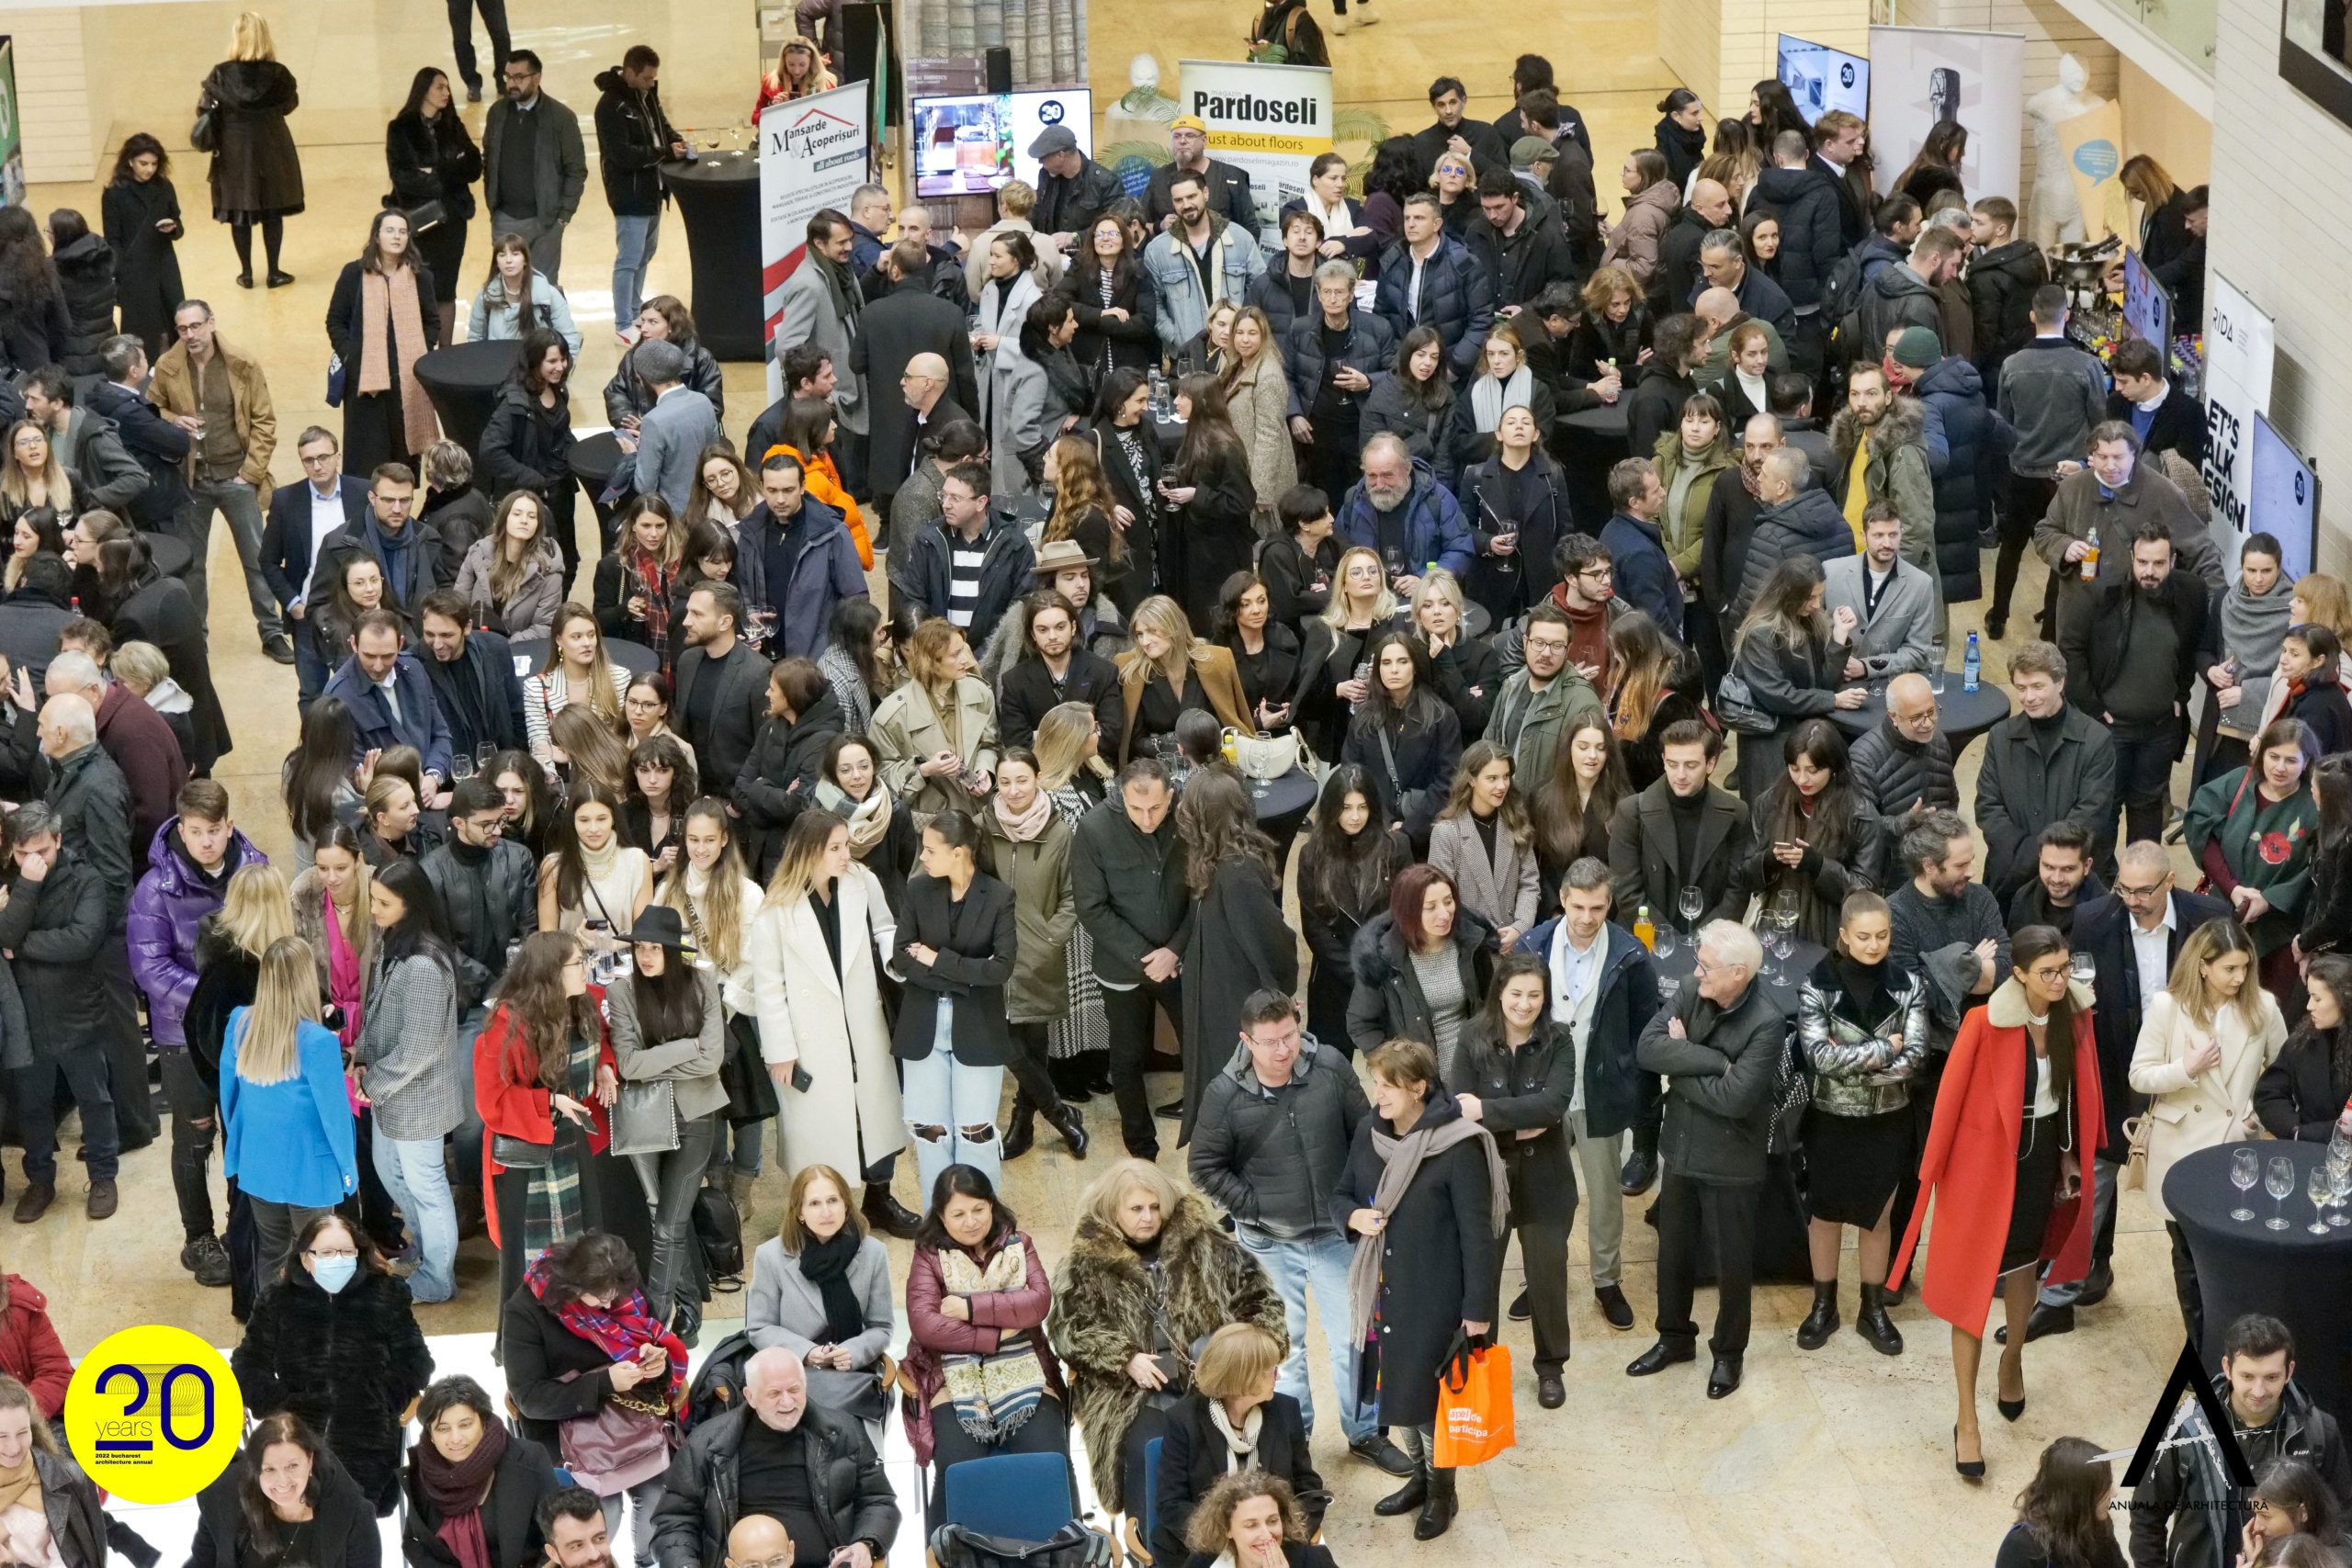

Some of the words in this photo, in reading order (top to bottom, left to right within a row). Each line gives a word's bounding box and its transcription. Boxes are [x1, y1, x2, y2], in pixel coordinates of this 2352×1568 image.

[1841, 66, 1854, 84] 20
[1210, 89, 1242, 97] magazin
[1041, 104, 1062, 121] 20
[1193, 90, 1317, 126] Pardoseli
[771, 118, 827, 155] Mansarde
[1207, 134, 1227, 145] ust
[1231, 135, 1266, 148] about
[1269, 137, 1305, 151] floors
[1279, 182, 1305, 195] ardoseli
[1260, 243, 1281, 254] Pardo
[2208, 398, 2240, 450] ET'S
[2202, 434, 2235, 484] ALK
[2204, 466, 2246, 534] ESIGN
[1450, 1409, 1470, 1420] apel
[1471, 1413, 1482, 1424] de
[1449, 1424, 1488, 1438] participa
